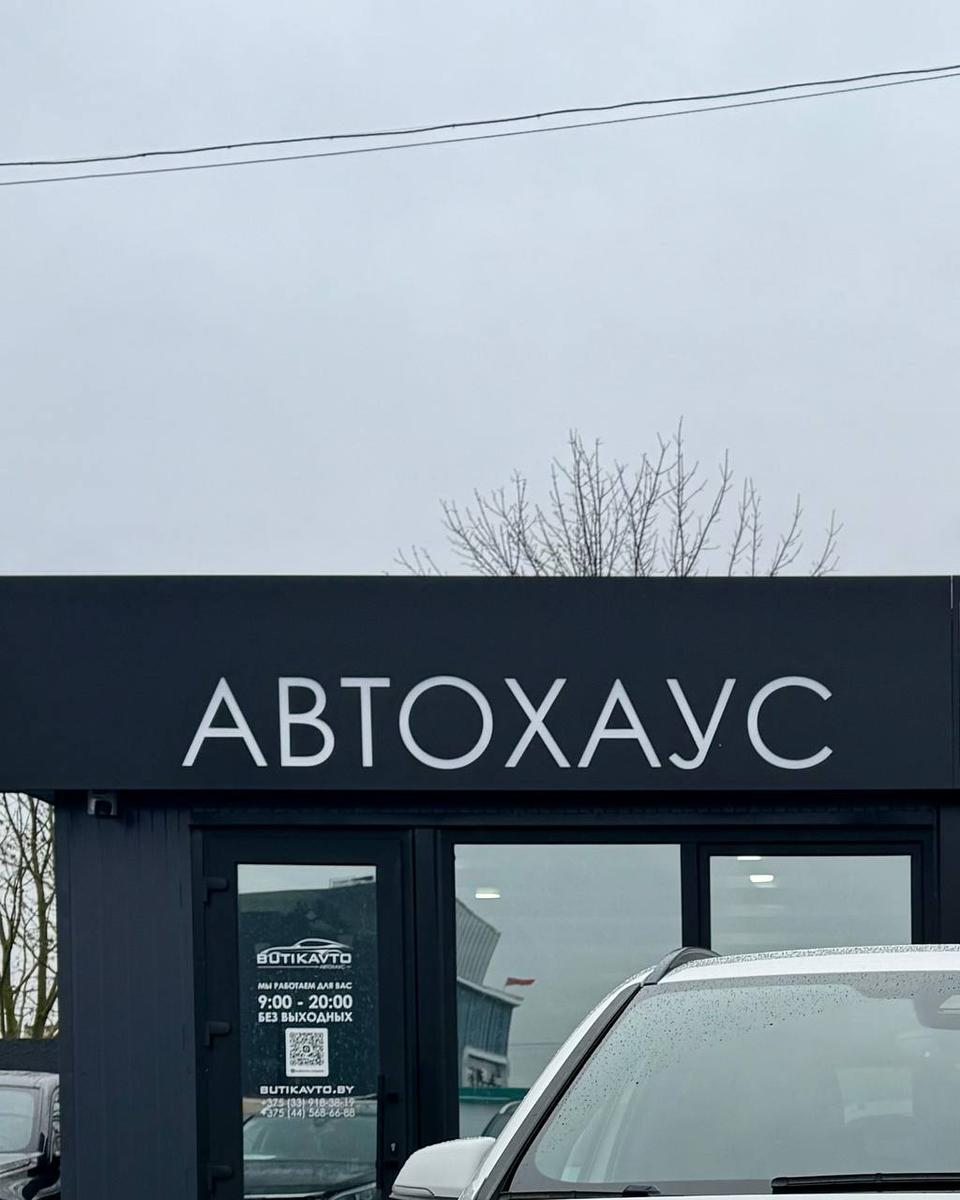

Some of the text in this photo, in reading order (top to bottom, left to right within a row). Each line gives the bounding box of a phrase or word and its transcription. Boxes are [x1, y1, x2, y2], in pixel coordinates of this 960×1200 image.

[181, 675, 834, 770] АВТОХАУС
[256, 951, 352, 964] BUTIKAVTO
[258, 982, 353, 990] МЫ РАБОТАЕМ ДЛЯ ВАС
[258, 995, 293, 1009] 9:00
[308, 994, 353, 1009] 20:00
[258, 1011, 353, 1023] БЕЗ ВЫХОДНЫХ
[260, 1085, 354, 1094] BUTIKAVTO.BY
